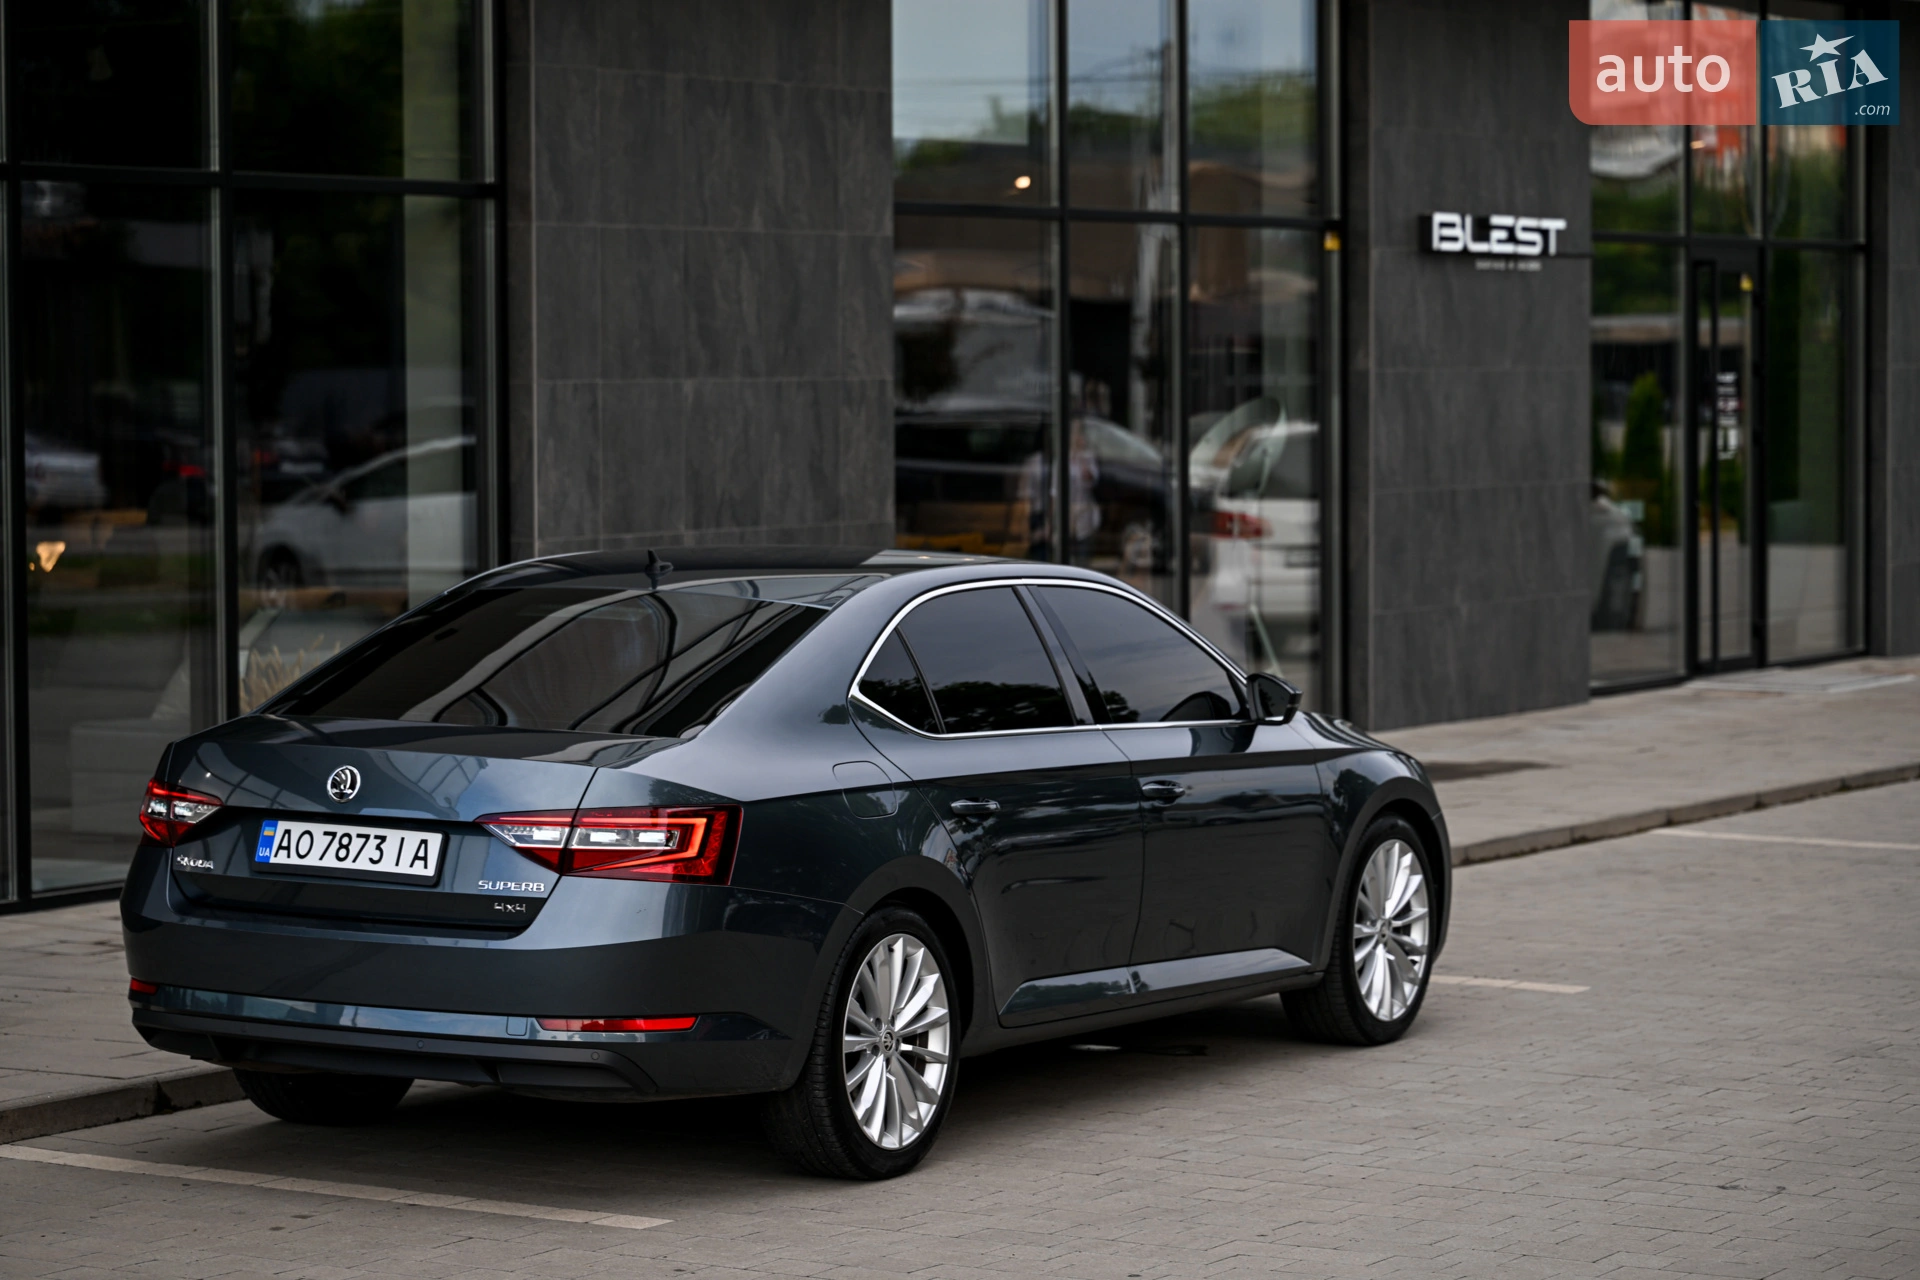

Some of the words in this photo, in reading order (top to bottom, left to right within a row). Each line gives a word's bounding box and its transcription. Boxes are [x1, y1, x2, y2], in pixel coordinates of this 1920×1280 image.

[1432, 211, 1567, 256] BLEST
[258, 847, 271, 857] UA
[318, 831, 388, 865] 7873
[478, 880, 545, 892] SUPERB
